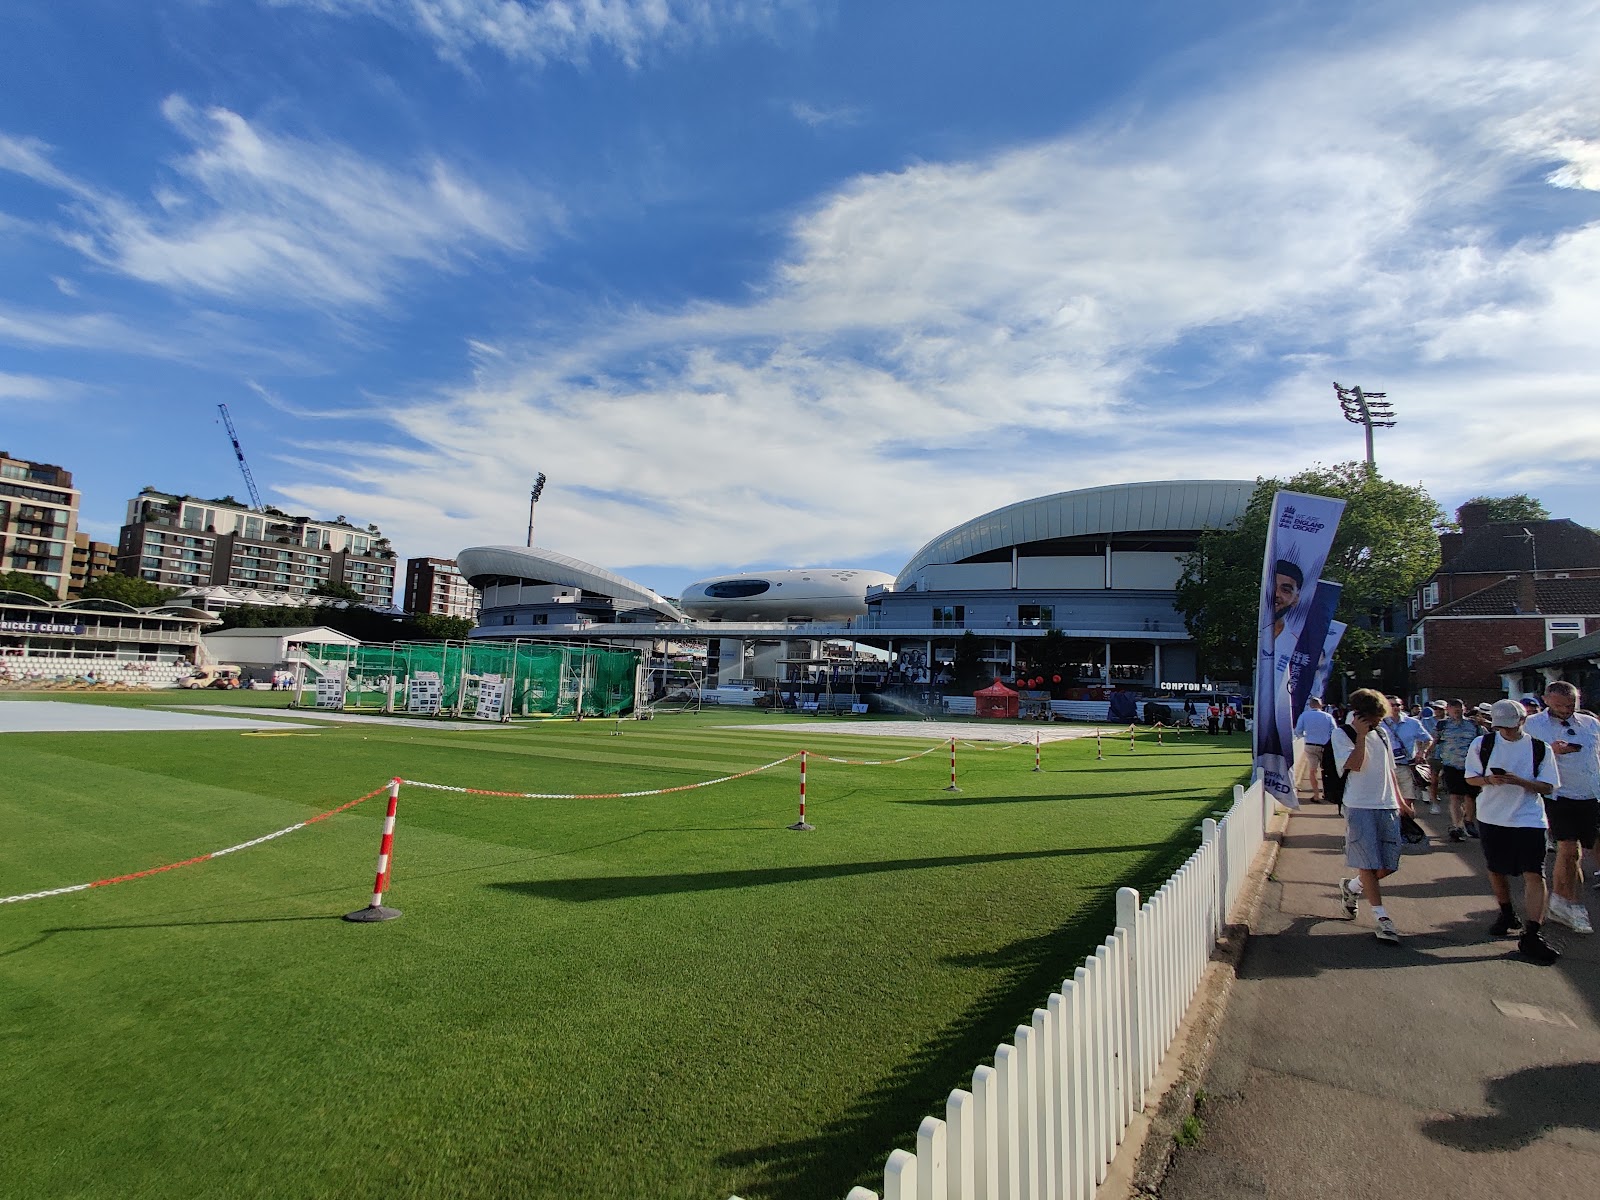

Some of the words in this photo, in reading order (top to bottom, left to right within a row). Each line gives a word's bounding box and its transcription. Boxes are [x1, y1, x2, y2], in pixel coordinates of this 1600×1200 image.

[1293, 524, 1320, 533] CRICKET
[1294, 519, 1324, 529] ENGLAND
[0, 621, 37, 630] RICKET
[40, 624, 76, 633] CENTRE
[1161, 682, 1200, 691] COMPTON
